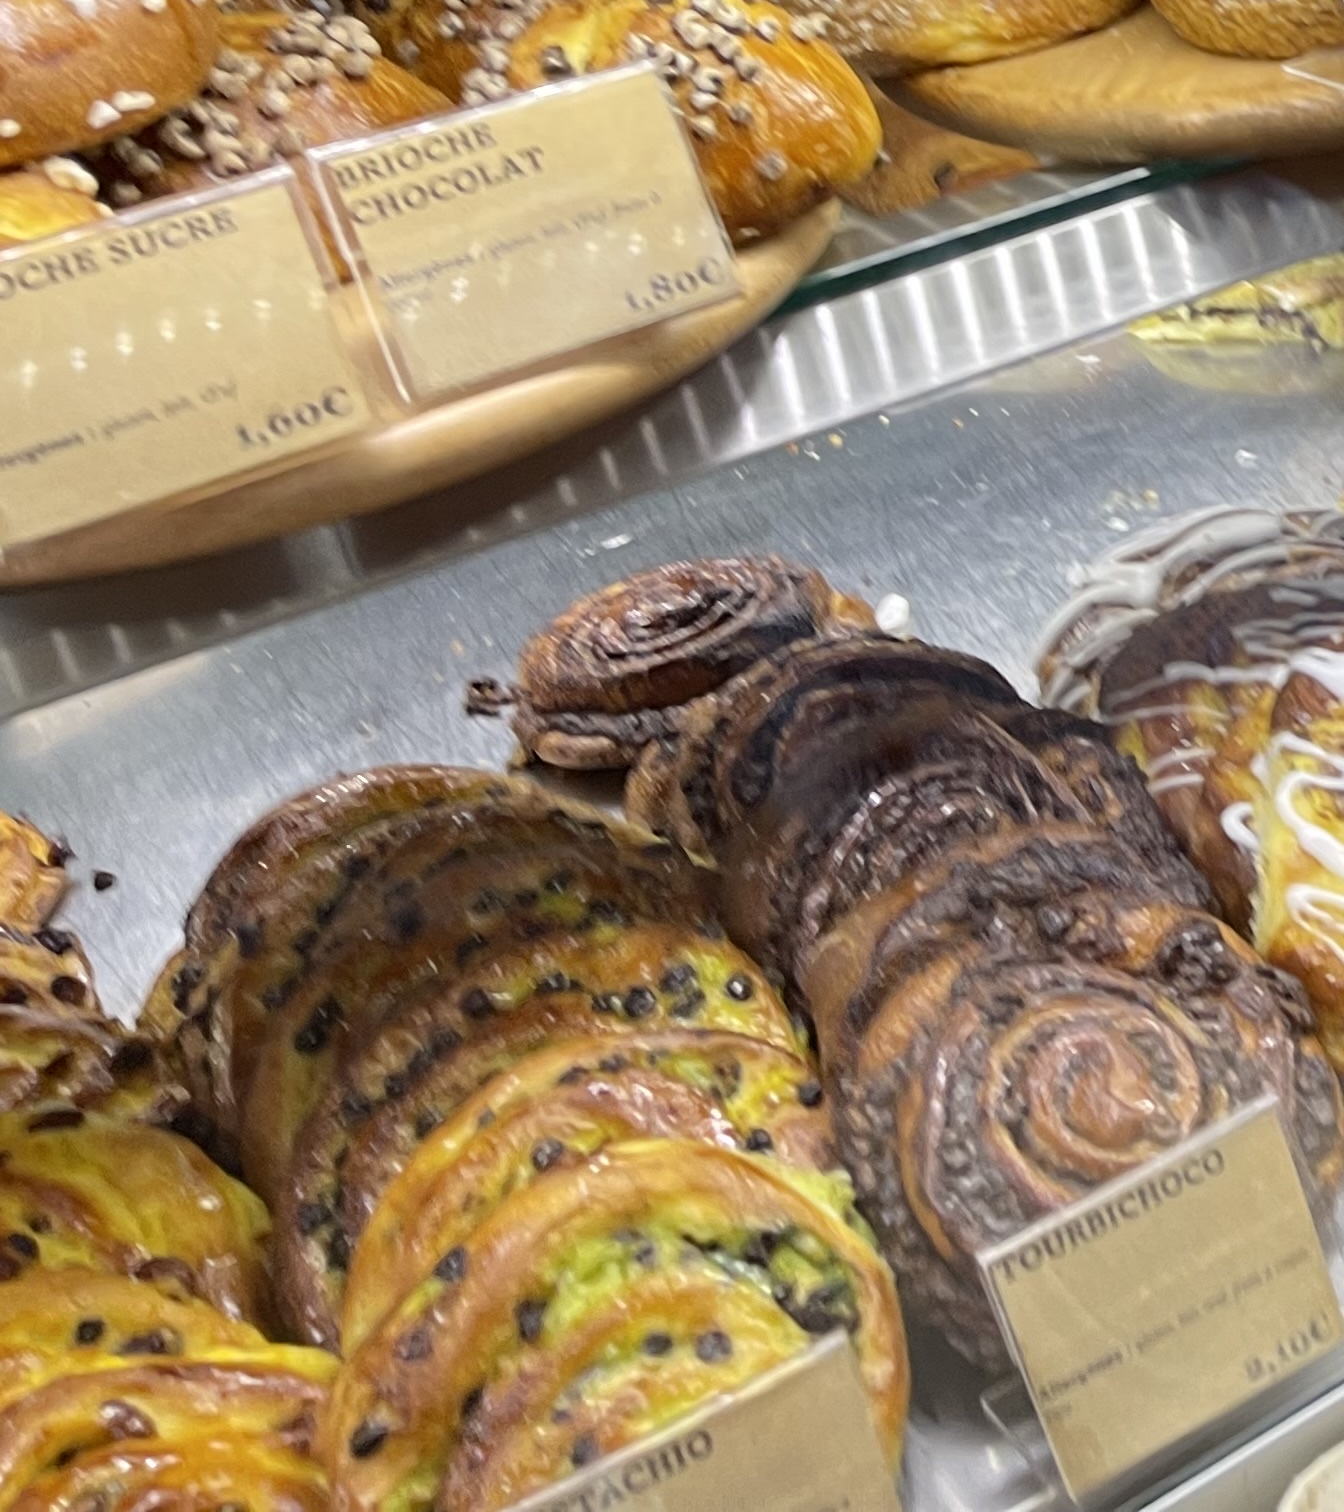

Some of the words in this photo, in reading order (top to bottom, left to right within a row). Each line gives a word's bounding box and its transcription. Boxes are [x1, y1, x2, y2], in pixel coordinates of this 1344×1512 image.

[335, 120, 498, 191] BRIOCHE
[348, 146, 547, 226] CHOCOLAT
[989, 1148, 1226, 1285] TOURBICHOCO
